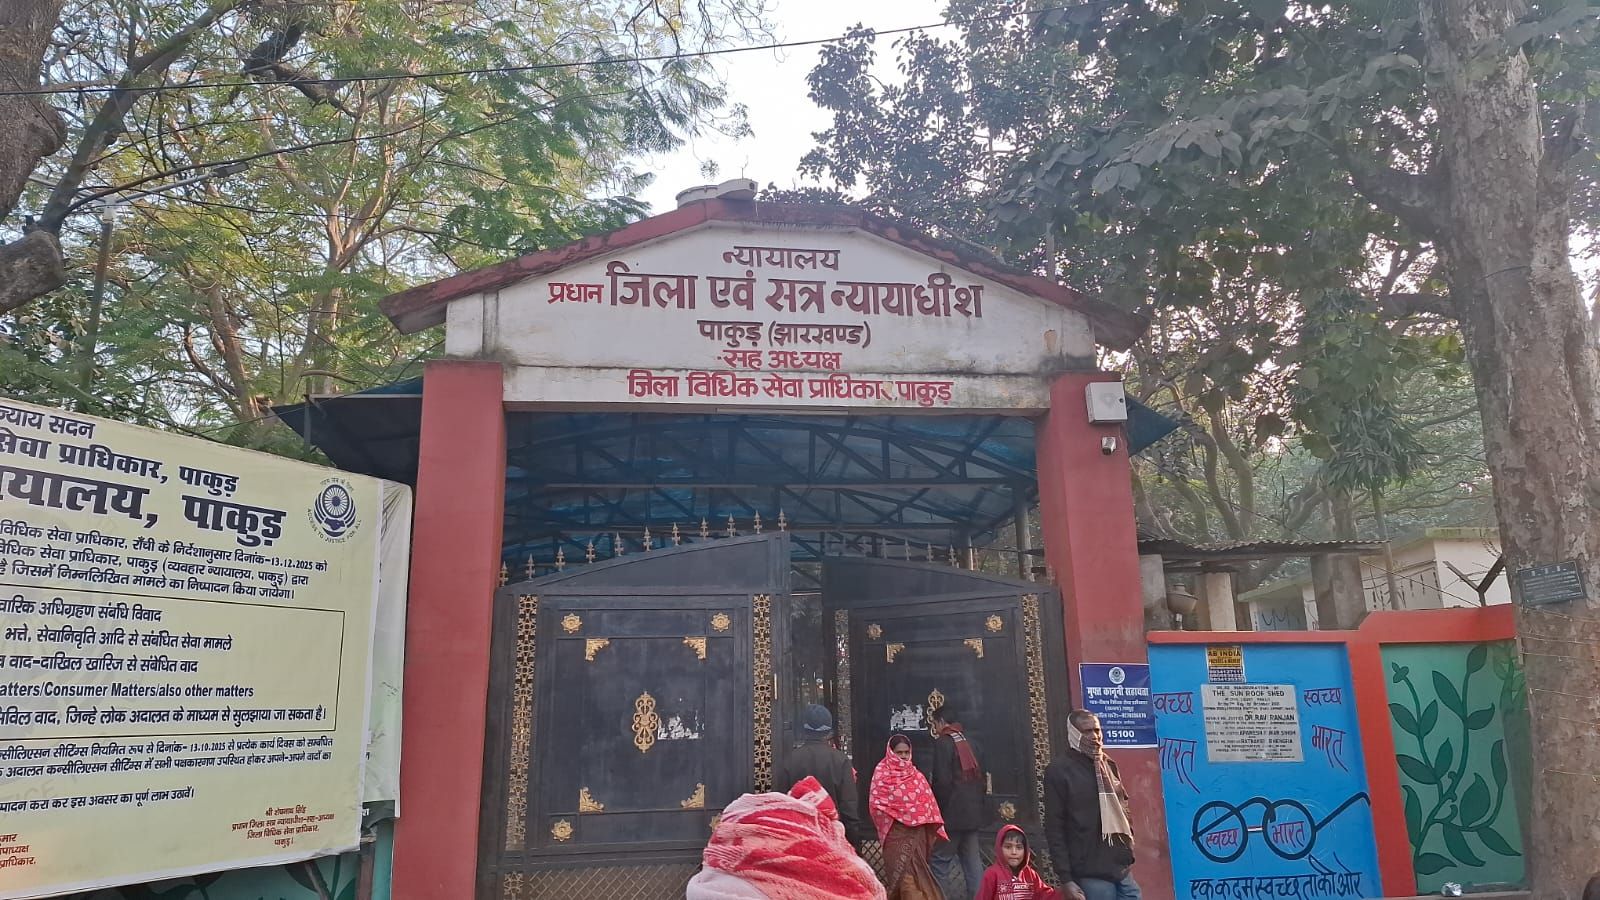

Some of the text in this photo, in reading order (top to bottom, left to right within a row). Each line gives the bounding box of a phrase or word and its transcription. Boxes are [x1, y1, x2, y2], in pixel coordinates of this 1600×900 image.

[723, 246, 840, 270] न्यायालय
[548, 261, 984, 318] प्रधान जिला एवं सत्र न्यायाधीश
[697, 320, 871, 348] पाकुड़ (झारखण्ड)
[768, 351, 842, 370] अध्यक्ष
[627, 370, 679, 397] जिला
[686, 372, 759, 397] विधिक
[762, 373, 804, 399] सेवा
[895, 382, 954, 406] पाकुड़
[49, 415, 96, 439] सदन
[59, 444, 168, 483] प्राधिकार,
[179, 466, 239, 498] पाकुड़
[0, 465, 287, 547] यालय, पाकुड़
[0, 519, 44, 538] विधिक
[47, 526, 72, 542] सेवा
[75, 530, 128, 550] प्राधिकार,
[132, 536, 155, 552] राँची
[158, 540, 173, 554] के
[173, 541, 232, 564] निर्देशानुसार
[315, 560, 328, 572] को
[40, 544, 66, 560] सेवा
[69, 548, 122, 567] प्राधिकार,
[163, 557, 206, 574] (व्यवहार
[291, 574, 309, 585] द्वारा
[12, 560, 56, 578] जिसमें
[57, 564, 129, 585] निम्नलिखित
[132, 574, 166, 588] मामले
[169, 578, 184, 590] का
[187, 577, 229, 593] निष्पादन
[232, 581, 257, 596] किया
[39, 597, 95, 618] अधिग्रहण
[132, 604, 162, 622] विवाद
[37, 625, 96, 649] सेवानिवृति
[99, 628, 126, 645] आदि
[128, 629, 139, 646] से
[181, 632, 201, 648] सेवा
[203, 634, 232, 650] मामले
[9, 651, 83, 670] वाद-दाखिल
[86, 653, 124, 670] खारिज
[127, 655, 138, 671] से
[180, 660, 198, 672] वाद
[0, 681, 254, 697] atters/Consumer Matters/also other matters
[1304, 687, 1342, 708] स्वच्छ
[1153, 692, 1194, 714] वच्छ
[35, 711, 60, 725] वाद,
[100, 706, 126, 722] लोक
[129, 709, 169, 722] अदालत
[172, 706, 184, 721] के
[187, 710, 219, 721] माध्यम
[221, 706, 230, 721] से
[233, 708, 271, 727] सुलझाया
[273, 709, 285, 720] जा
[288, 708, 313, 720] सकता
[1106, 730, 1135, 738] 15100
[0, 745, 51, 760] सीलिएसन
[91, 742, 126, 756] नियमित
[128, 745, 144, 754] रूप
[146, 741, 154, 754] से
[228, 738, 235, 750] से
[237, 738, 257, 750] प्रत्येक
[1312, 724, 1349, 772] भारत
[6, 766, 44, 777] अदालत
[144, 756, 154, 769] में
[155, 756, 172, 769] सभी
[174, 757, 215, 768] पक्षकारगण
[217, 753, 246, 766] उपस्थित
[247, 753, 266, 764] होकर
[322, 752, 332, 760] का
[29, 799, 50, 810] करा
[52, 797, 70, 808] कर
[70, 796, 87, 808] इस
[88, 794, 119, 806] अवसर
[120, 793, 133, 804] का
[135, 788, 149, 807] पूर्ण
[151, 790, 169, 802] लाभ
[1205, 828, 1240, 849] स्वच्छ
[1272, 821, 1305, 848] भारत
